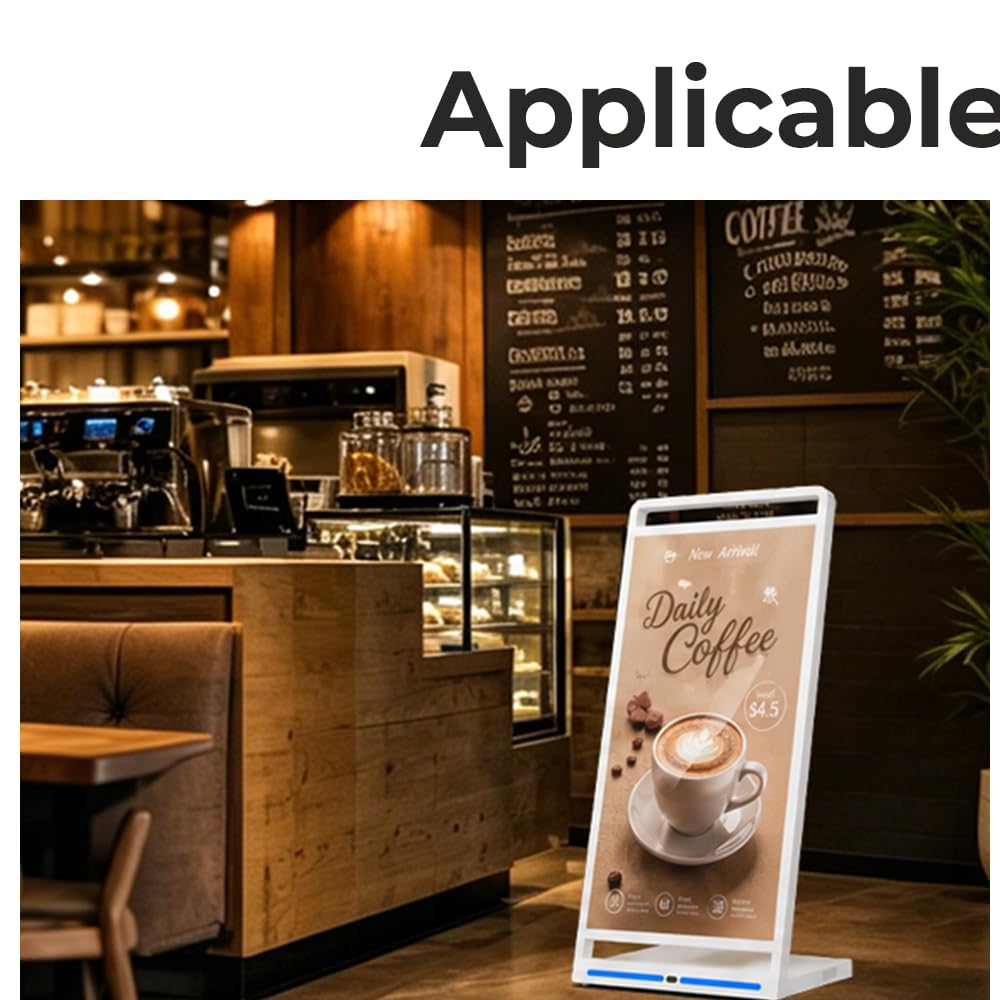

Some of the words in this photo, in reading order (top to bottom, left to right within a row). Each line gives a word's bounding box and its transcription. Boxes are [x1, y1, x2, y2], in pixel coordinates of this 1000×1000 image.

[642, 585, 726, 635] Daily
[662, 616, 778, 679] Coffee
[749, 700, 779, 718] $4.5
